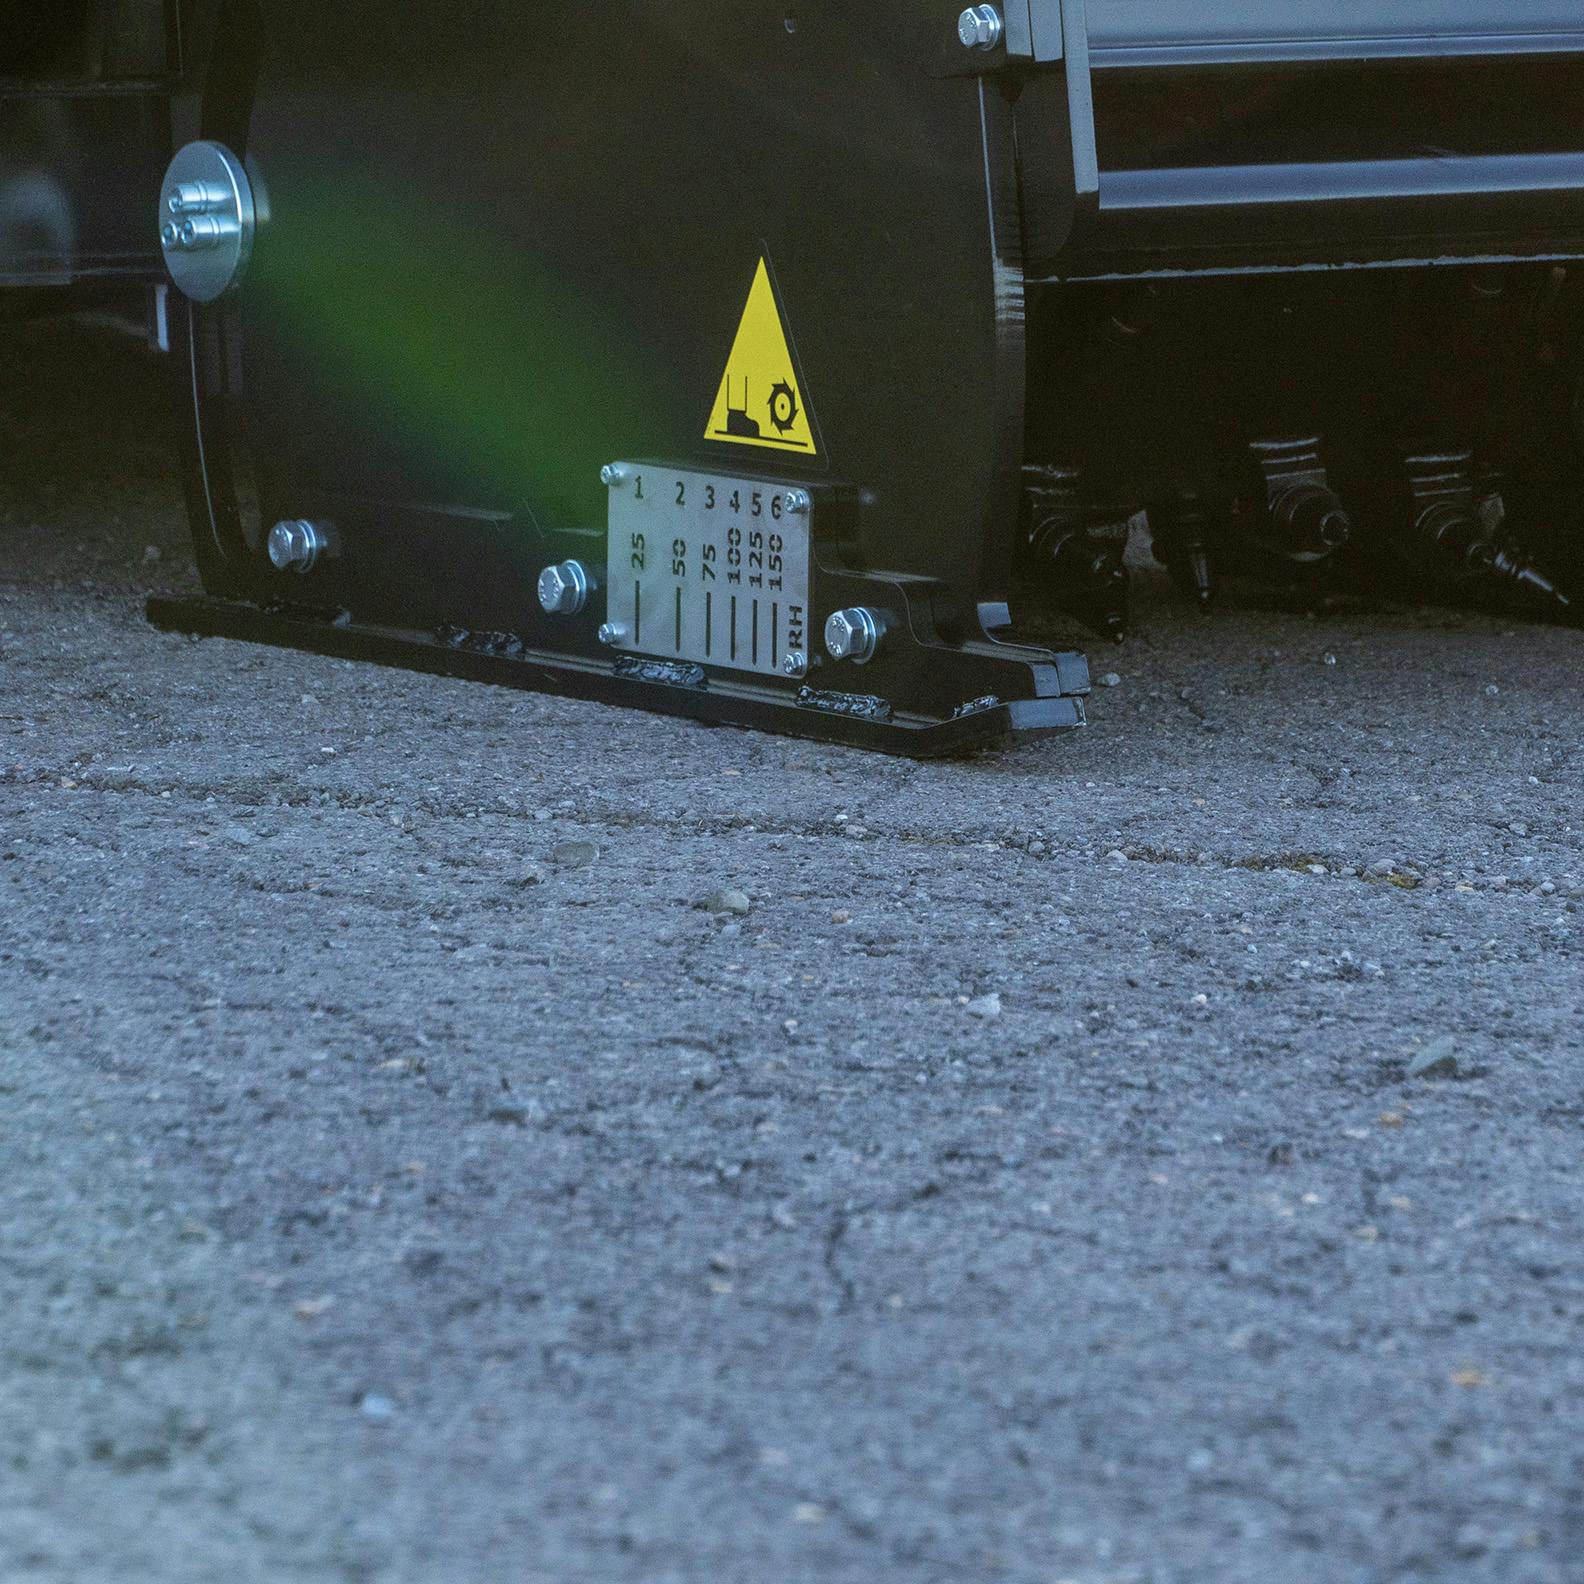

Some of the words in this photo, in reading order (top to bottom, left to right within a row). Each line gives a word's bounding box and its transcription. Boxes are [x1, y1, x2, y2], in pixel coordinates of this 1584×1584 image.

[634, 475, 643, 499] 1
[676, 481, 685, 506] 2
[705, 485, 715, 510] 3
[729, 490, 740, 514] 4
[751, 493, 762, 517] 5
[771, 495, 782, 520] 6
[631, 532, 645, 570] 25
[672, 539, 686, 577] 50
[702, 544, 716, 581] 75
[727, 527, 741, 585] 100
[749, 531, 763, 589] 125
[768, 534, 783, 592] 150
[789, 605, 803, 649] RH
